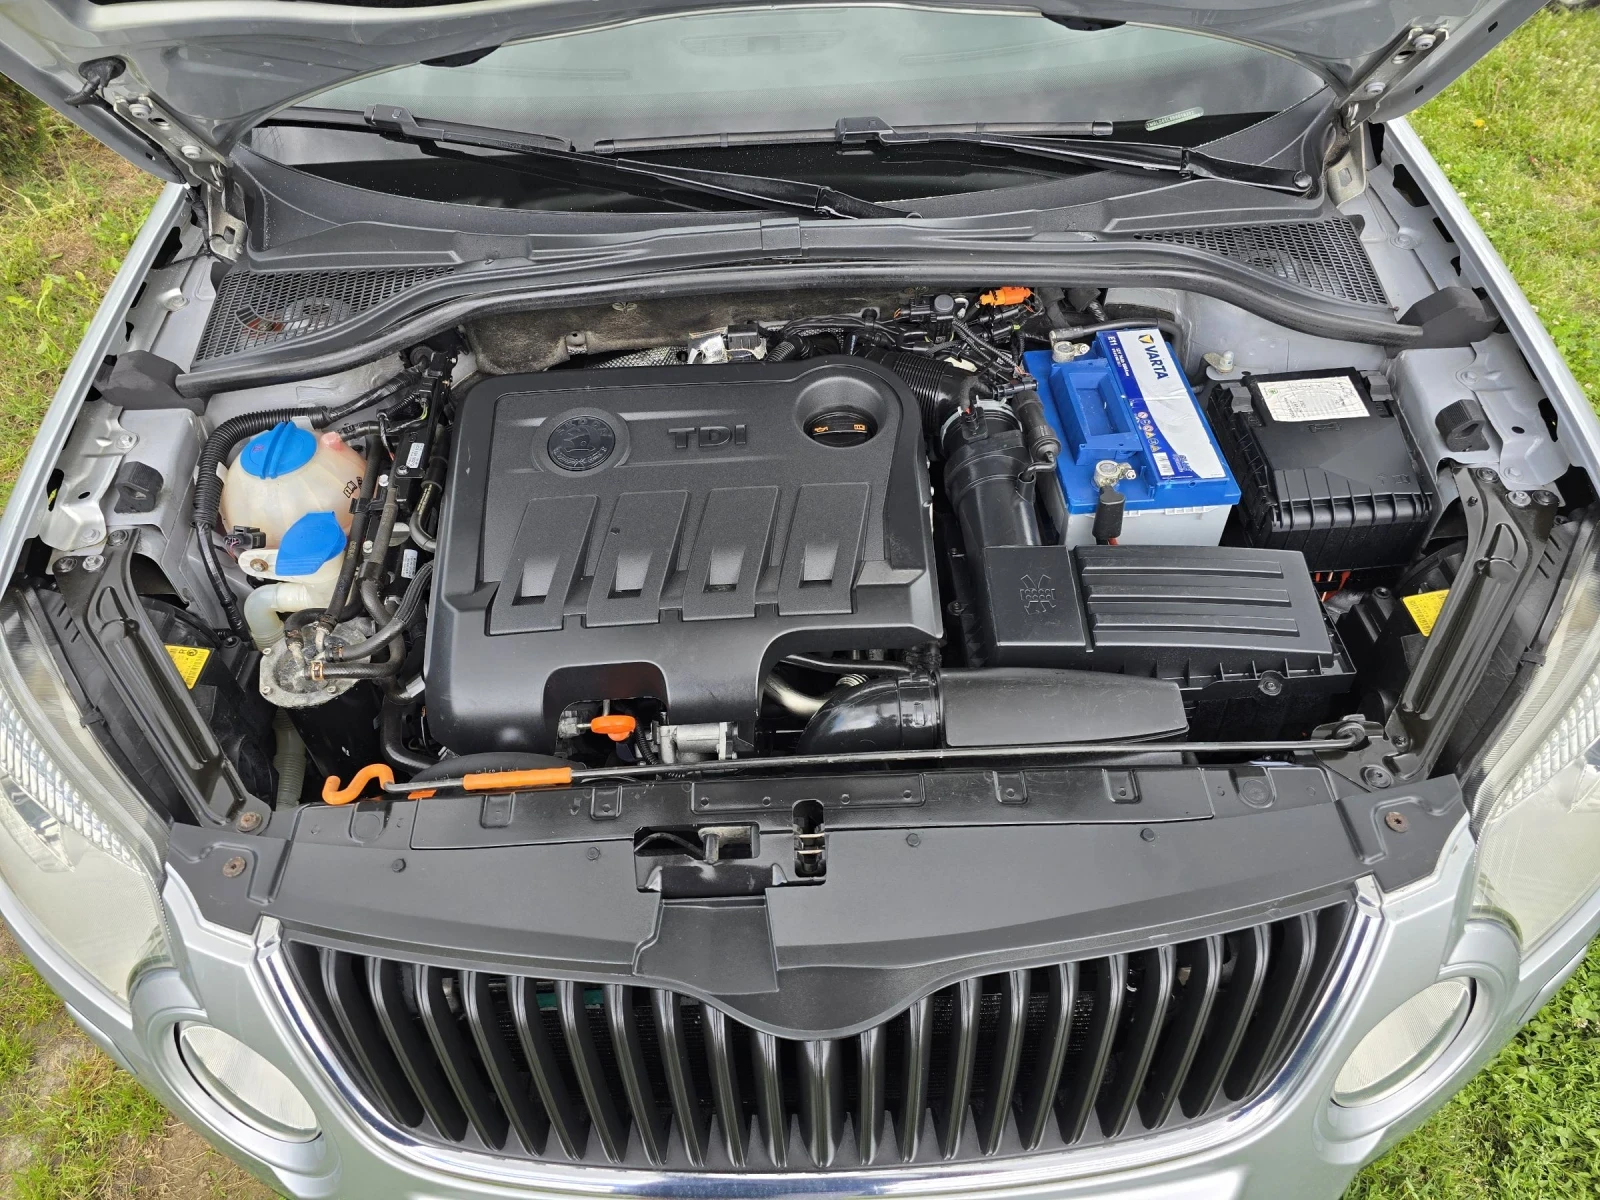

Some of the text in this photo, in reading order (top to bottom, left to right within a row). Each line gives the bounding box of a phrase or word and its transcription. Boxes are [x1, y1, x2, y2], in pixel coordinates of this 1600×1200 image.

[1107, 336, 1118, 346] E11
[1145, 346, 1168, 379] VARTA
[667, 424, 747, 449] TDI
